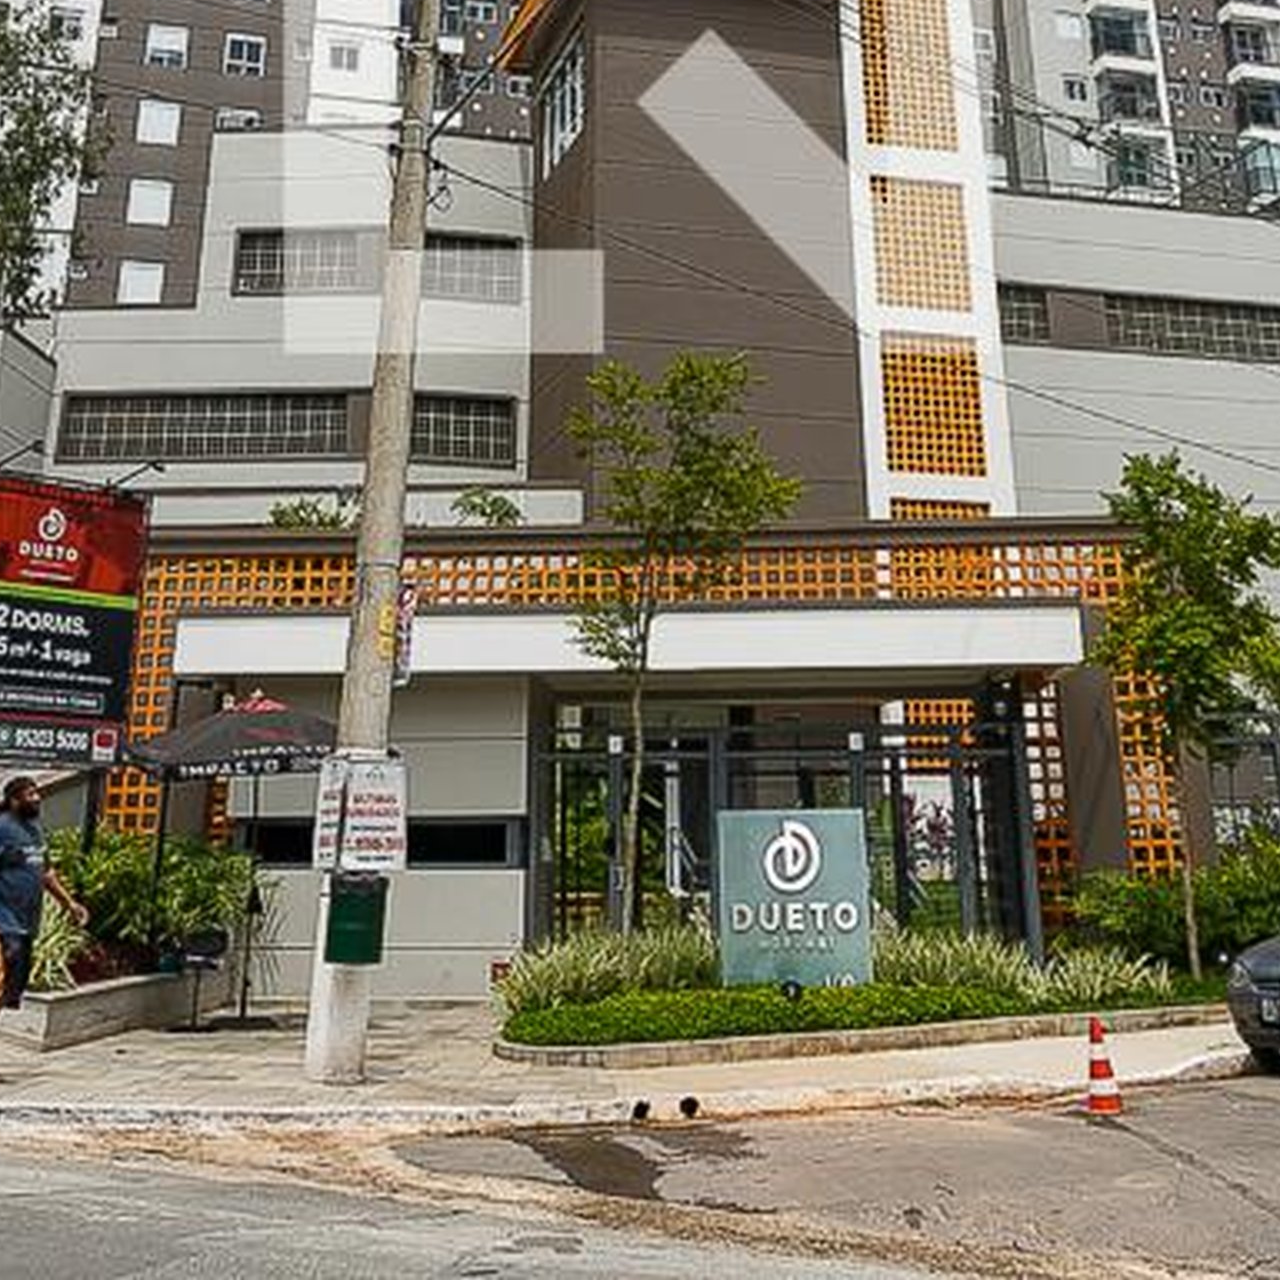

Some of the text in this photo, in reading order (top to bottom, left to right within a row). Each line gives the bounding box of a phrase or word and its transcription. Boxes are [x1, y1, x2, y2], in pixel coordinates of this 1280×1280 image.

[19, 541, 79, 561] DUETO
[232, 745, 331, 757] IMPACTO
[179, 758, 279, 776] IMPACTO
[732, 901, 858, 931] DUETO
